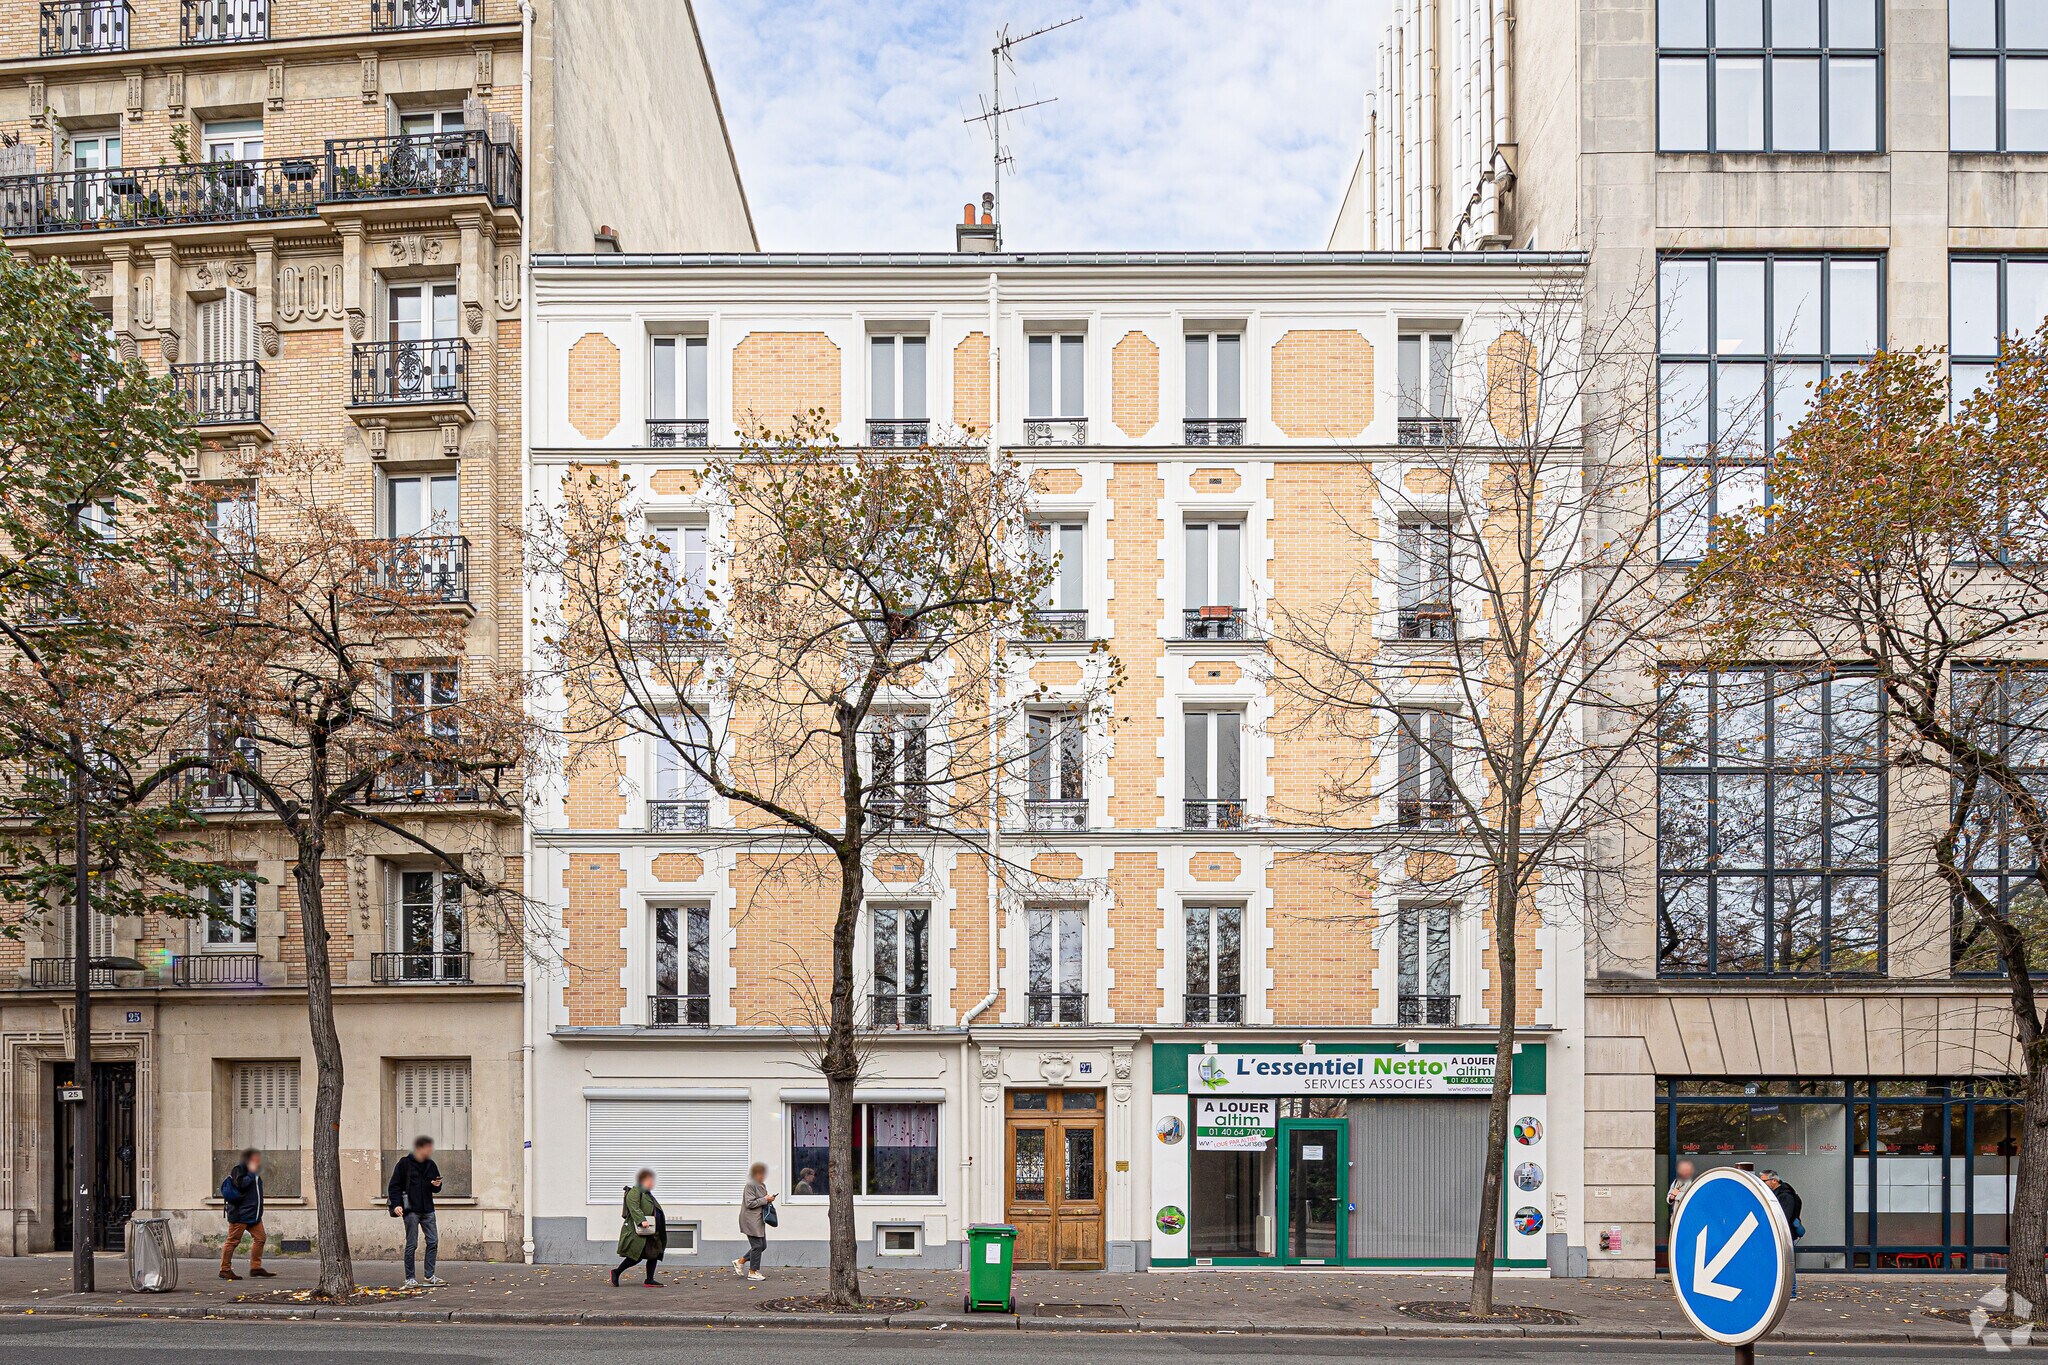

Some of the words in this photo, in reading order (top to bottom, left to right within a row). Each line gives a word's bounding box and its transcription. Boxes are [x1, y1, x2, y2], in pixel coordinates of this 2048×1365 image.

[128, 1012, 140, 1022] 25
[1451, 1057, 1458, 1065] A
[1461, 1057, 1495, 1065] LOUER
[1080, 1063, 1091, 1073] 27
[1373, 1057, 1448, 1078] Netto
[1456, 1066, 1491, 1076] altim
[1304, 1079, 1365, 1089] SERVICES
[1369, 1077, 1433, 1089] ASSOCIÉS
[1204, 1102, 1214, 1112] A
[1219, 1102, 1269, 1113] LOUER
[1214, 1113, 1260, 1126] altim
[1208, 1128, 1218, 1136] 01
[1221, 1128, 1232, 1136] 40
[1233, 1128, 1244, 1136] 64
[1246, 1128, 1267, 1137] 7000
